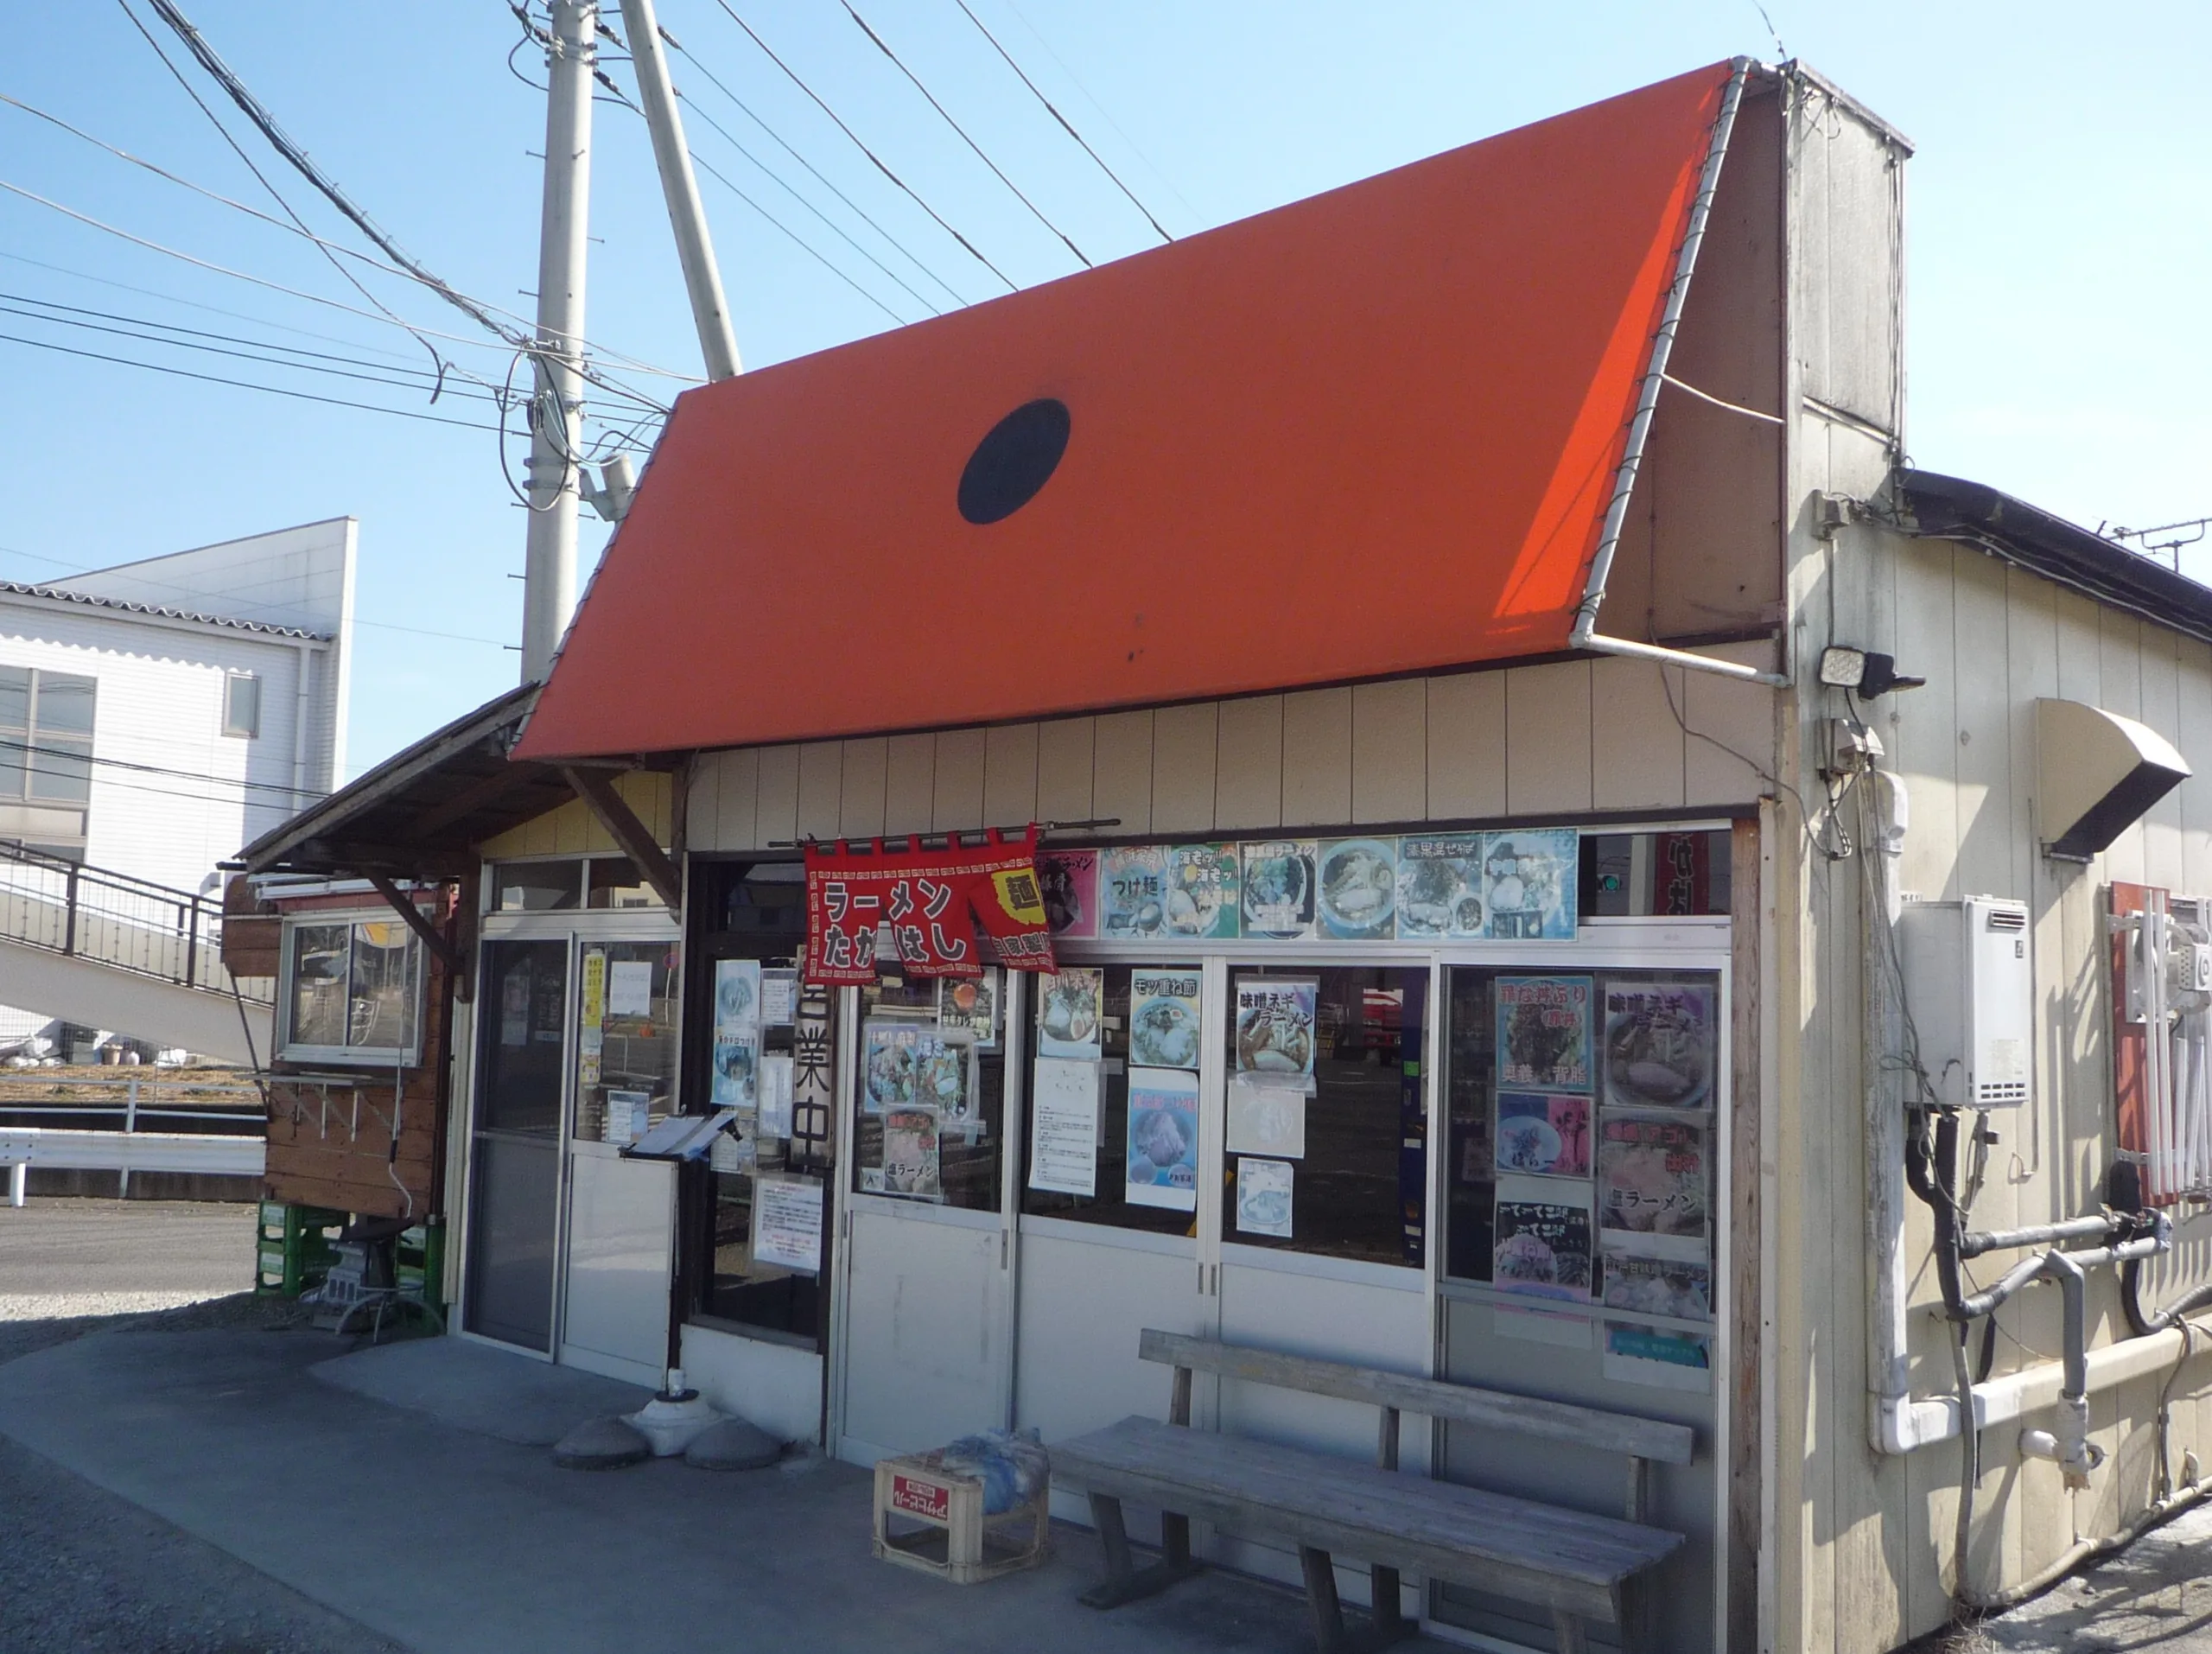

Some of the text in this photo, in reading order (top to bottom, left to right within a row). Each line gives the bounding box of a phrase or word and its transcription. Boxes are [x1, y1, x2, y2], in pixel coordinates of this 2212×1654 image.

[824, 877, 951, 922] ラーメン
[1005, 875, 1040, 910] 麺
[1112, 875, 1159, 897] つけ麺
[823, 922, 967, 969] たかはし
[992, 931, 1050, 957] 自家製
[1135, 977, 1197, 997] モツ重ね節
[1261, 1009, 1313, 1028] ラーメン
[893, 1490, 948, 1518] アサヒビール
